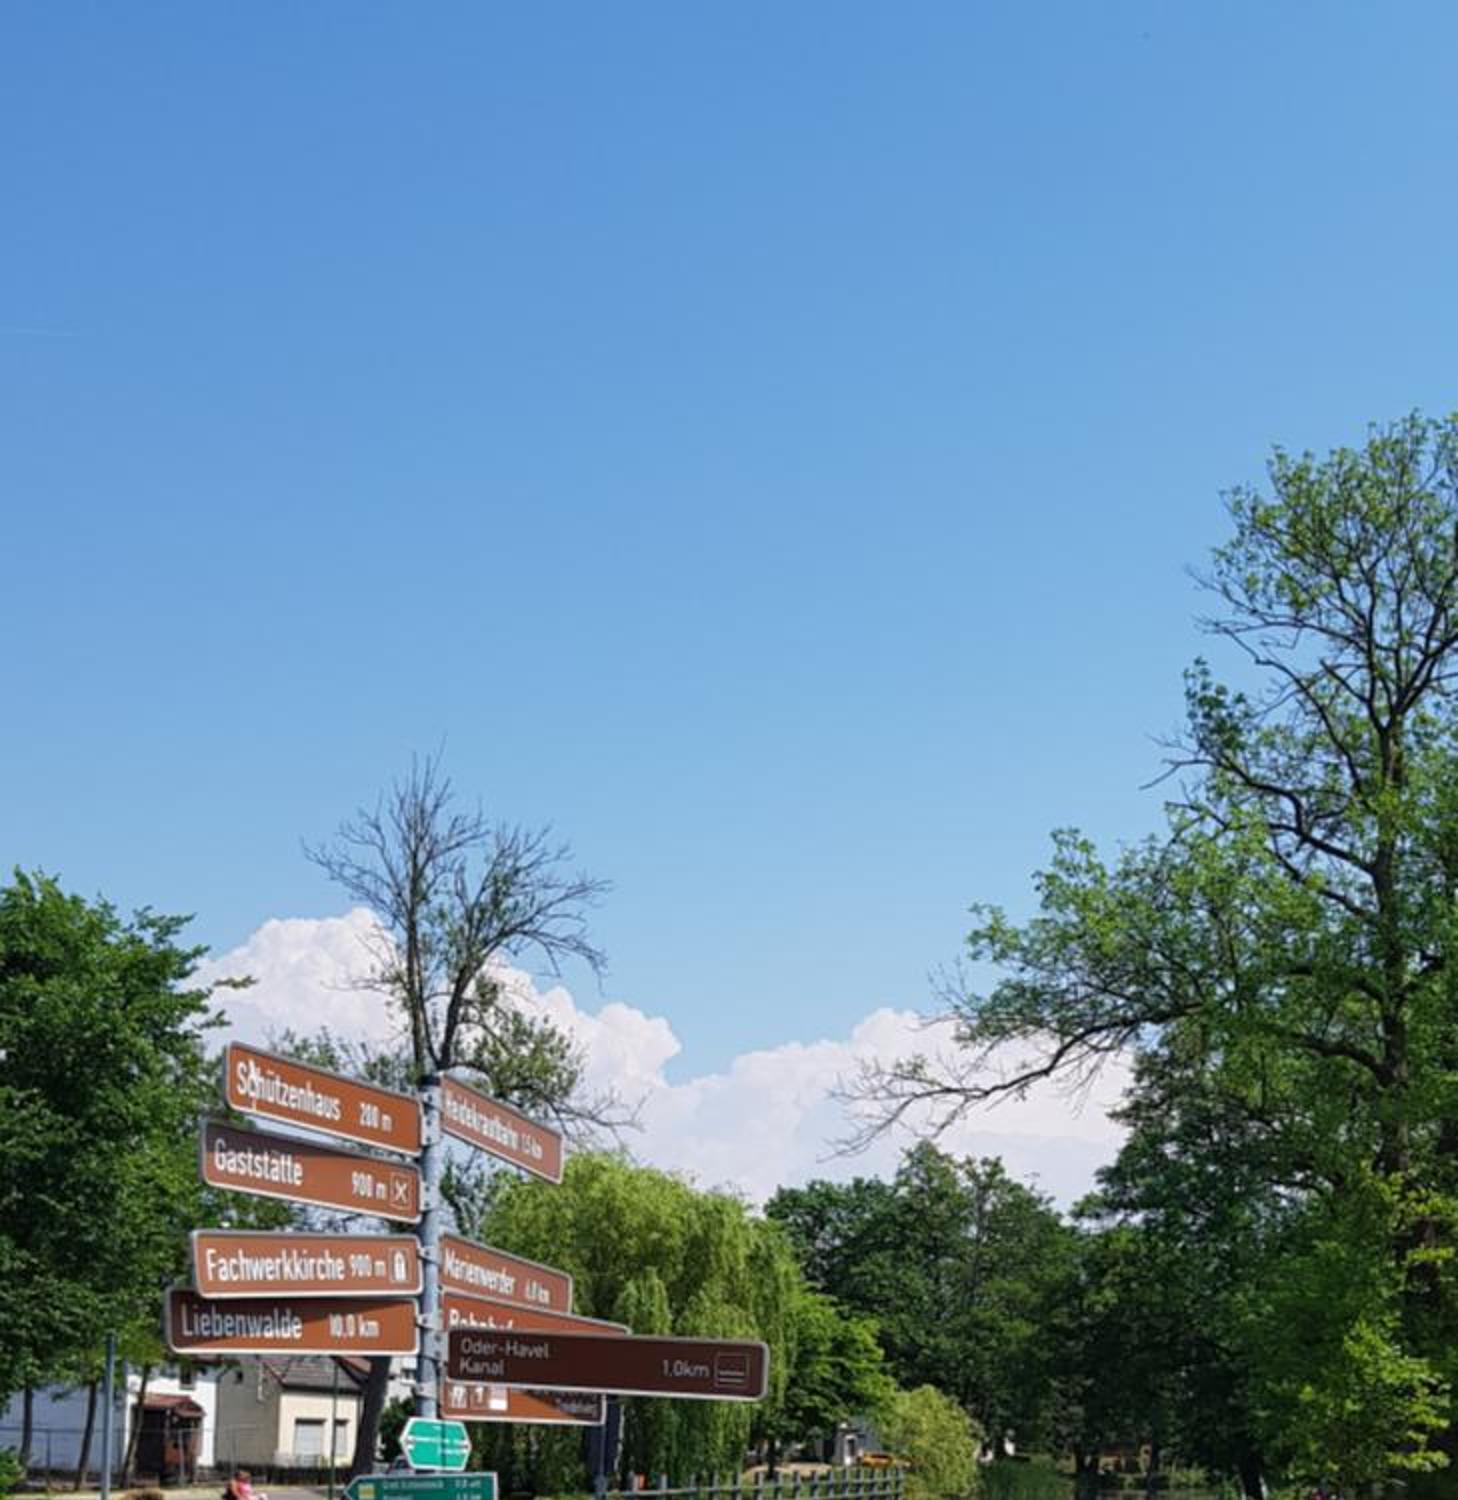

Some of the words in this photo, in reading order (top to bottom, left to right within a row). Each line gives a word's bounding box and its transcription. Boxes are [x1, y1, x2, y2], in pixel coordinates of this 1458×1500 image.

[236, 1060, 341, 1121] Schützenhaus
[359, 1102, 379, 1128] 200
[382, 1113, 392, 1132] m
[214, 1138, 303, 1186] Gaststätte
[352, 1171, 373, 1198] 900
[376, 1181, 386, 1199] m
[206, 1248, 345, 1281] Fachwerkkirche
[349, 1254, 370, 1277] 900
[375, 1259, 385, 1276] m
[445, 1247, 515, 1295] Marienwerder
[181, 1304, 303, 1339] Liebenwalde
[358, 1313, 379, 1338] km
[460, 1339, 549, 1359] Oder-Havel
[459, 1358, 504, 1376] Kanal
